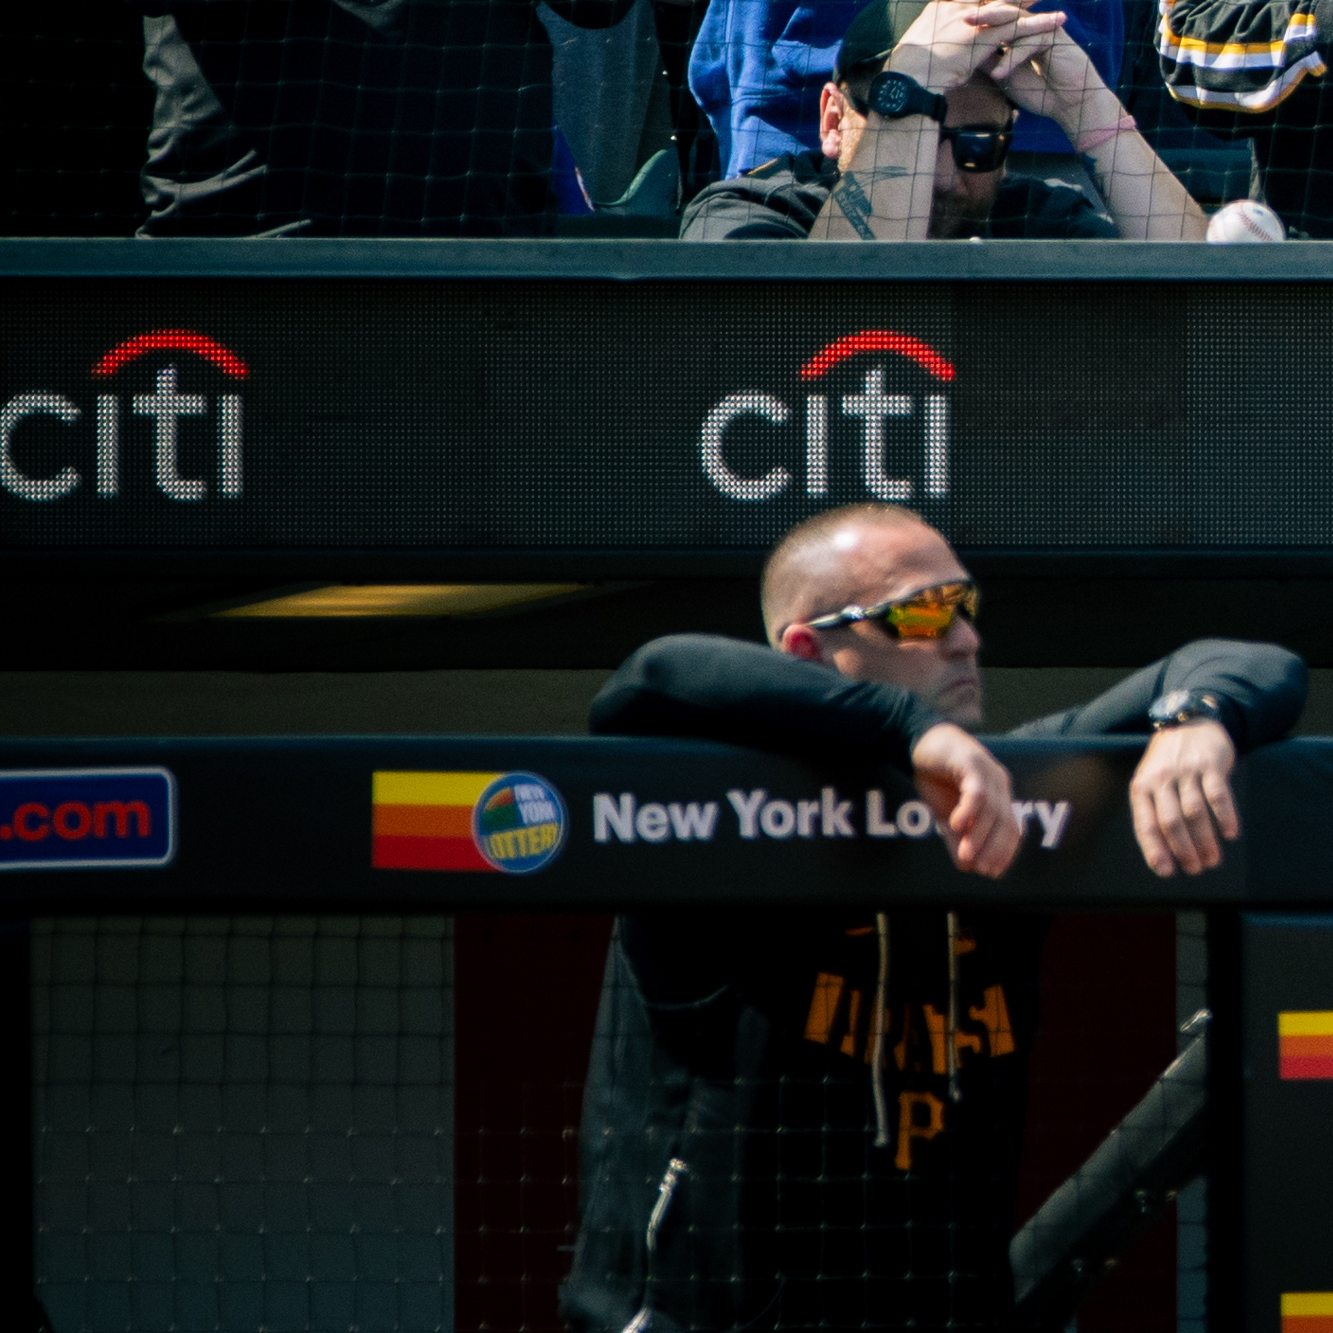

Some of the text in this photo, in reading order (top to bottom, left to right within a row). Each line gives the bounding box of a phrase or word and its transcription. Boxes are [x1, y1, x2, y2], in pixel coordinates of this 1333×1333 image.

[0, 365, 244, 500] citi
[700, 365, 950, 501] citi
[594, 787, 1069, 848] New York Lory
[894, 1090, 944, 1171] P
